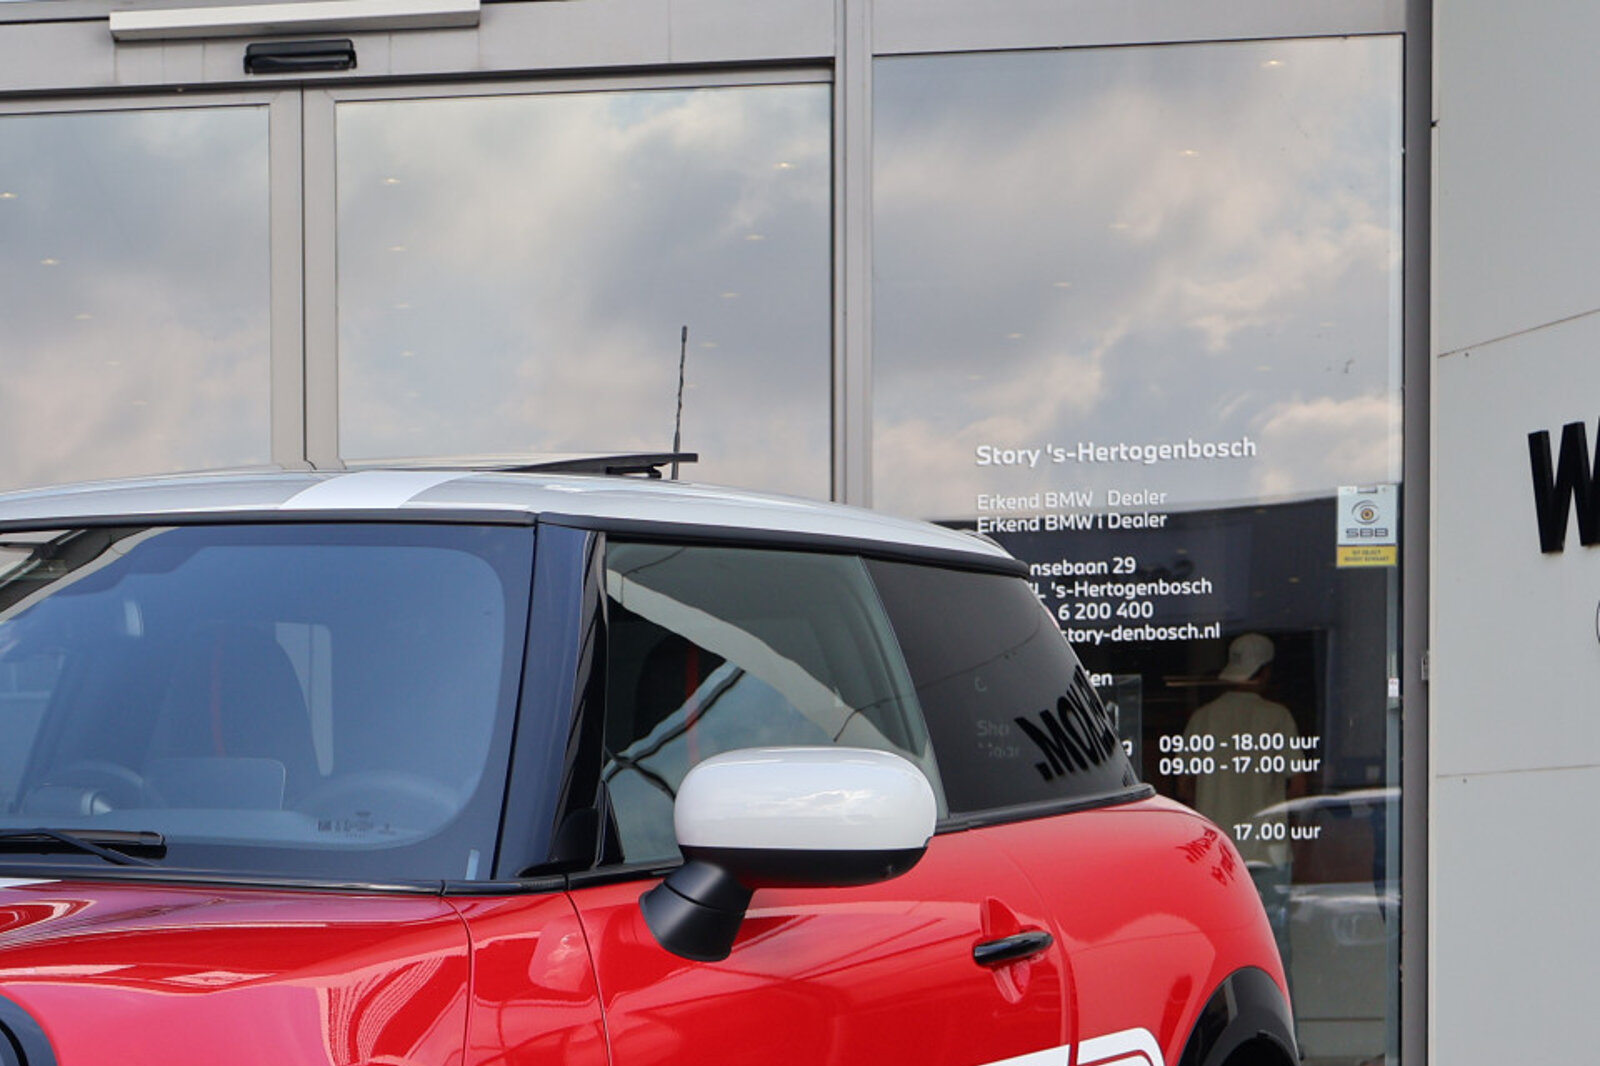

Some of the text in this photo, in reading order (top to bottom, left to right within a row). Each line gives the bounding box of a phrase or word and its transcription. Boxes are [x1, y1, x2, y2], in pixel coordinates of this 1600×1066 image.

[976, 437, 1257, 468] Story 's-Hertogenbosch
[977, 489, 1168, 510] Erkend BMW Dealer
[977, 511, 1168, 533] Erkend BMW i Dealer
[1029, 556, 1137, 576] nsebaan 29
[1051, 577, 1213, 600] 's-Hertogenbosch
[1058, 601, 1154, 621] 6 200 400
[1159, 735, 1215, 753] 09.00
[1232, 733, 1284, 752] 18.00
[1289, 733, 1321, 751] uur
[1159, 757, 1215, 776] 09.00
[1289, 756, 1321, 773] uur
[1290, 824, 1322, 840] uur
